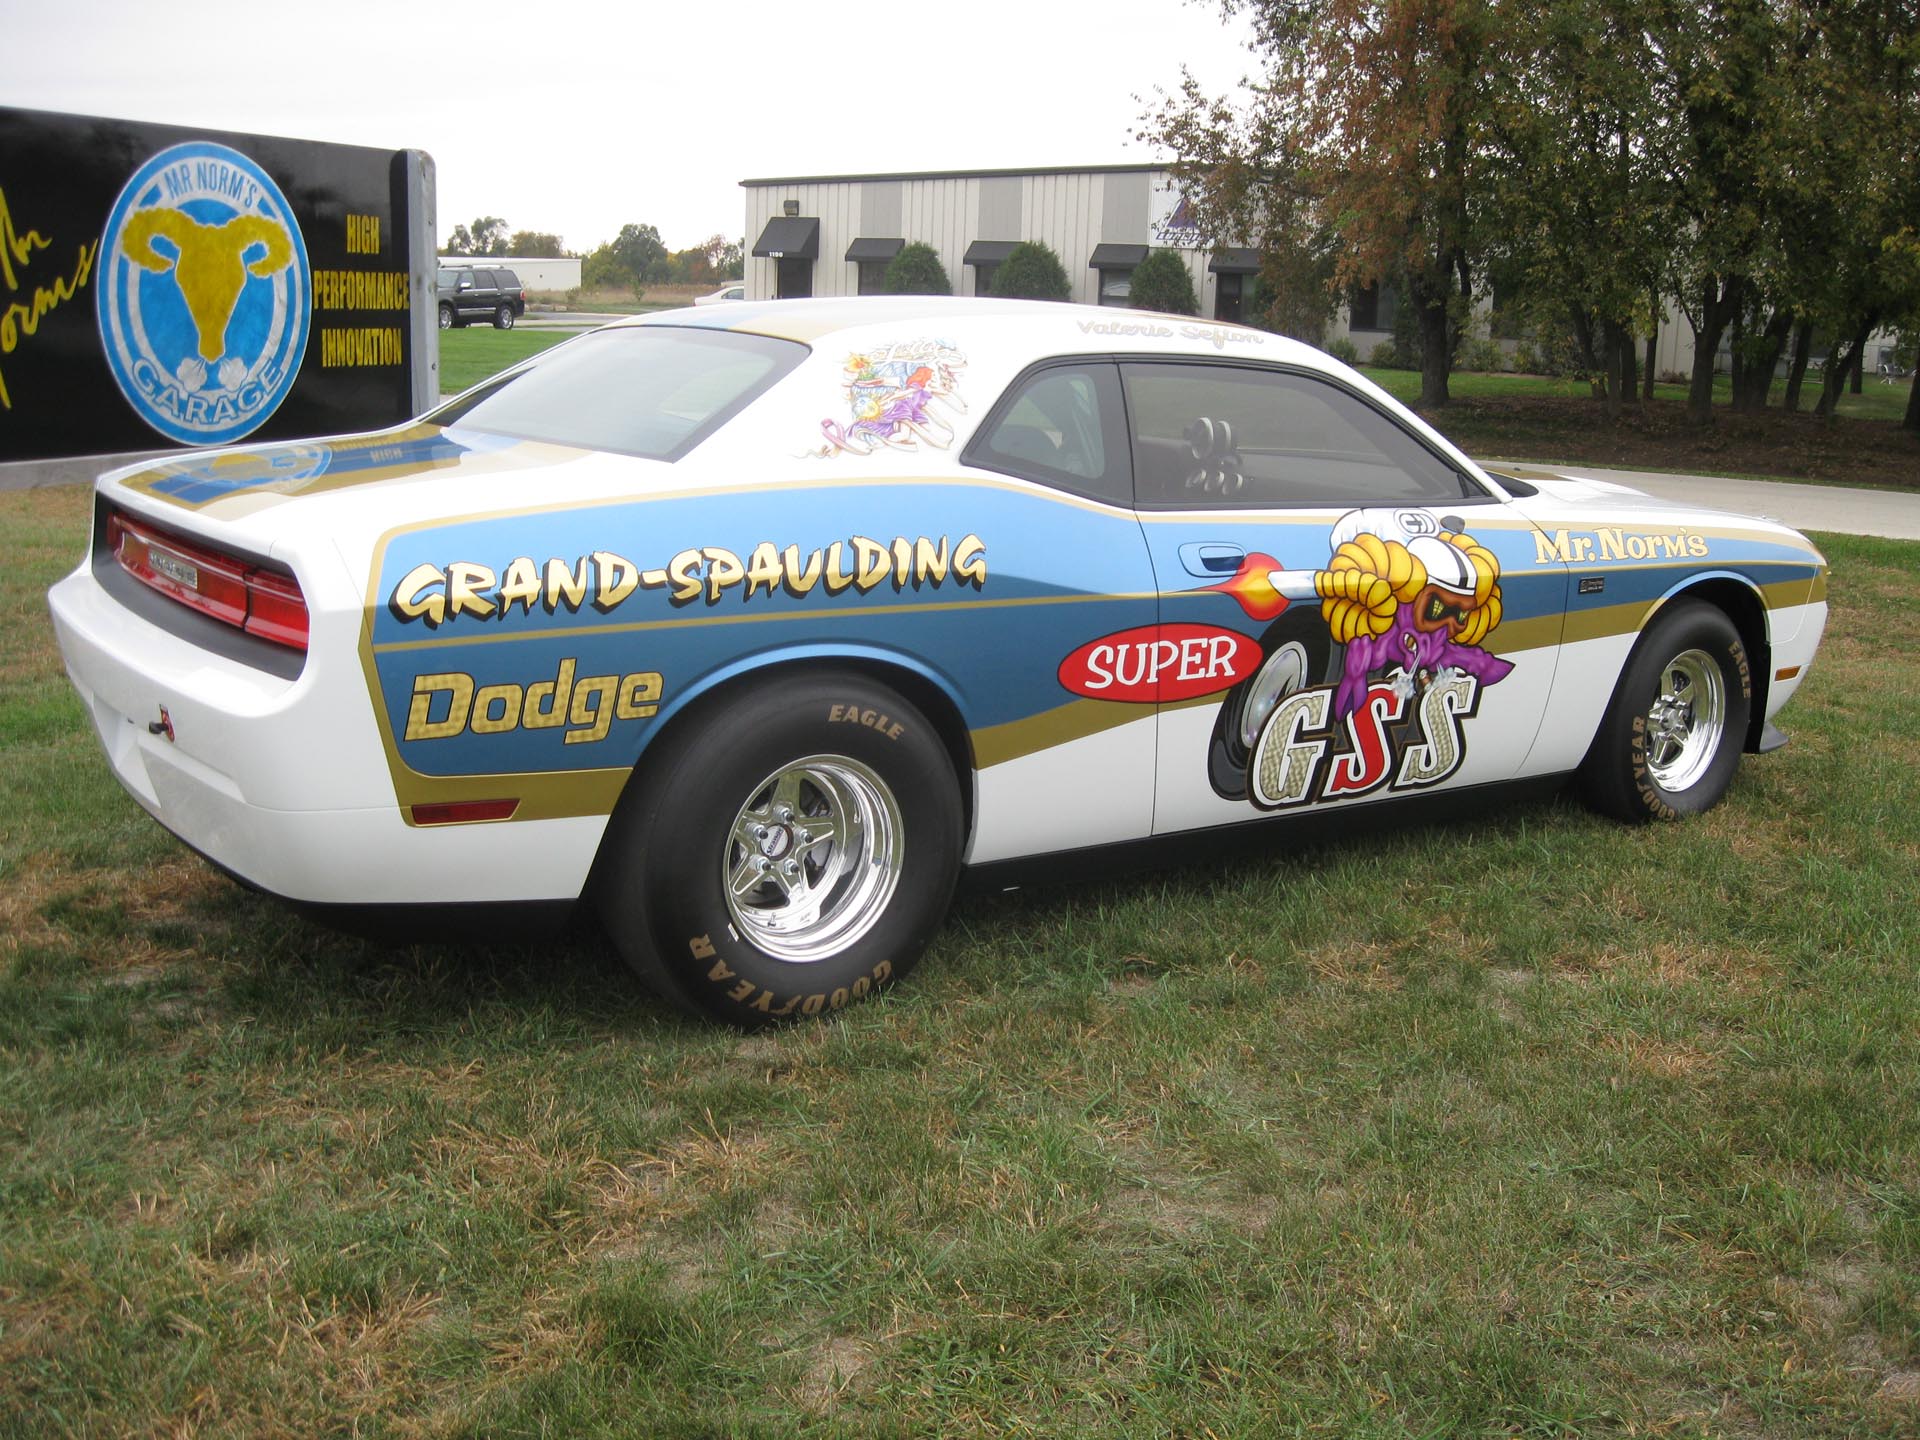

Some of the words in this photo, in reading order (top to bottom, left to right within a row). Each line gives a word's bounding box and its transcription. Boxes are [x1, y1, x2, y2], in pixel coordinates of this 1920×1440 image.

[164, 167, 193, 201] MR
[196, 161, 258, 208] NORM'S
[345, 213, 380, 255] HIGH
[312, 270, 410, 310] PERFORMANCE
[321, 327, 403, 368] INNOVATION
[131, 357, 284, 424] GARAGE
[388, 533, 987, 631] GRAND-SPAULDING
[1083, 635, 1238, 690] SUPER
[1727, 640, 1753, 699] EAGLE
[402, 656, 663, 746] Dodge
[828, 704, 905, 741] EAGLE
[1248, 675, 1479, 808] GSS
